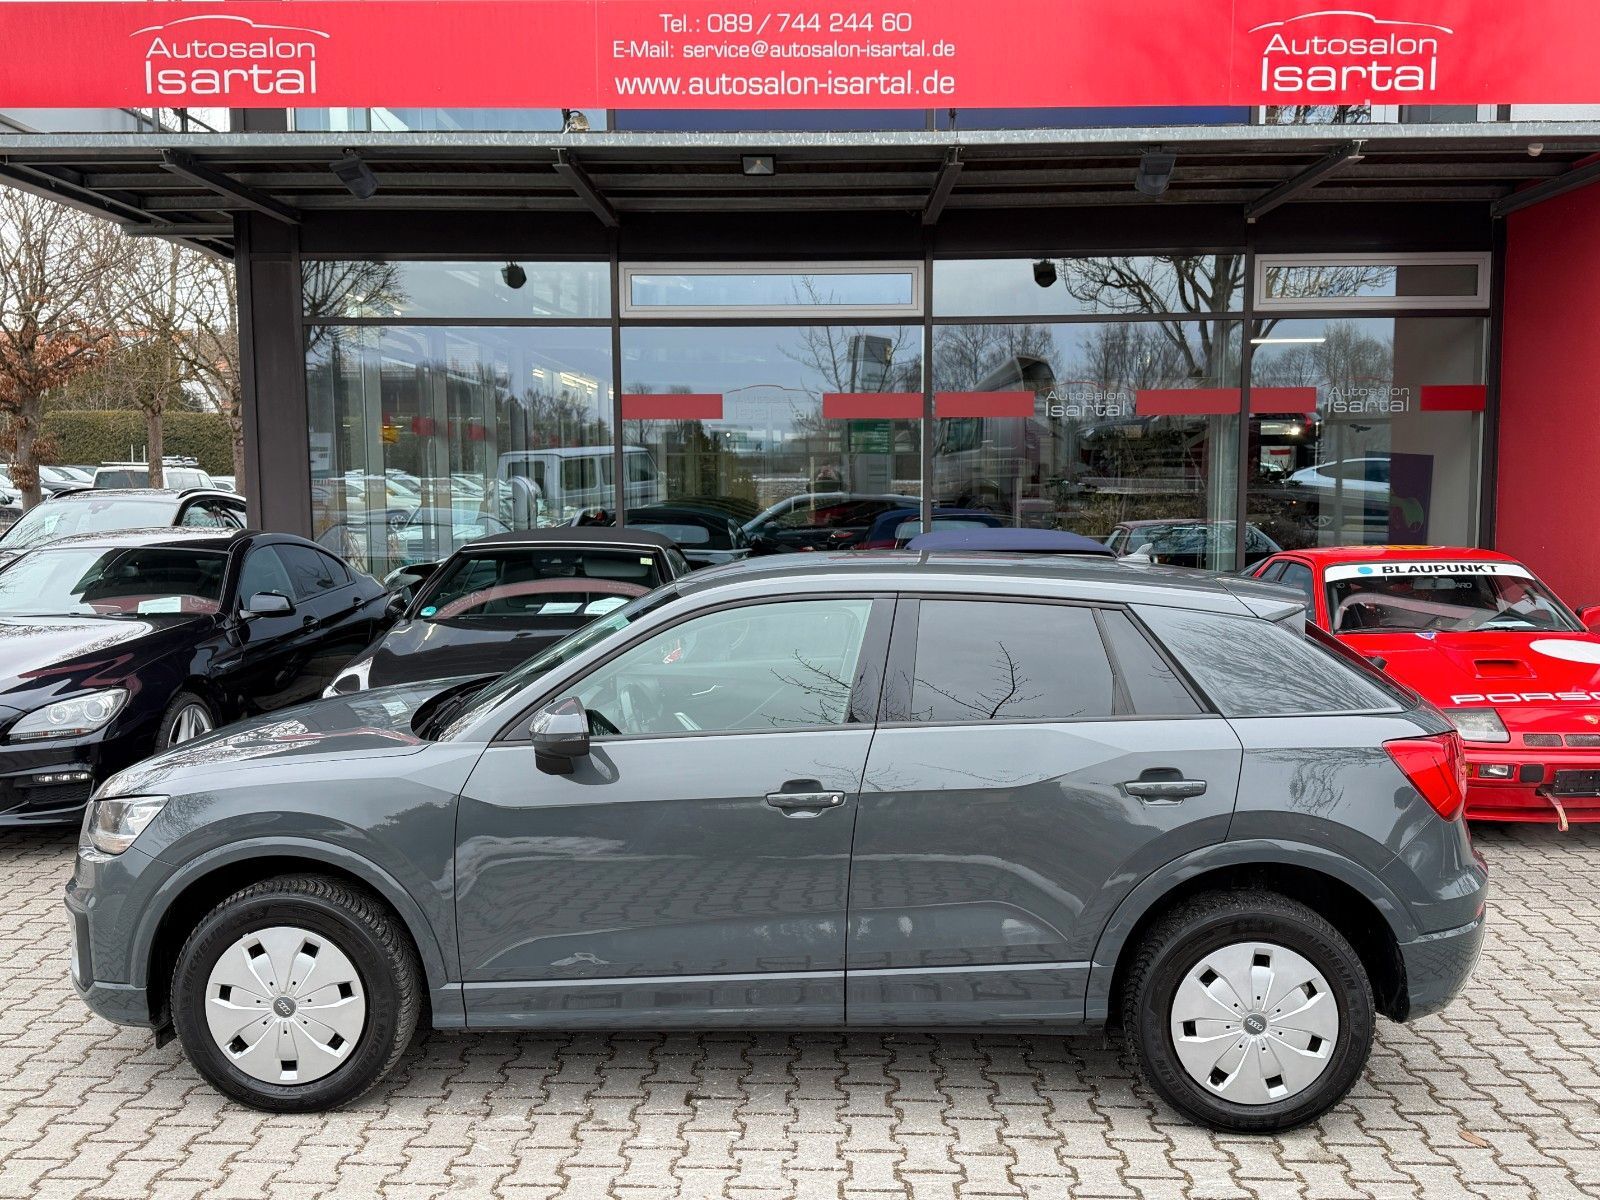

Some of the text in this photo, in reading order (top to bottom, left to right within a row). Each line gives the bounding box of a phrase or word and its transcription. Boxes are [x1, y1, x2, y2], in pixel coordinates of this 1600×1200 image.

[659, 13, 700, 33] Tel.:
[707, 13, 753, 33] 089
[776, 13, 821, 32] 744
[829, 12, 874, 32] 244
[881, 12, 912, 32] 60
[145, 37, 316, 59] Autosalon
[613, 39, 955, 58] E-Mail: service@autosalon-isartal.de
[1263, 33, 1437, 55] Autosalon
[145, 60, 317, 94] Isartal
[614, 69, 955, 96] www.autosalon-isartal.de
[1261, 56, 1437, 92] Isartal
[1046, 389, 1126, 401] Autosalon
[1329, 386, 1410, 396] Autosalon
[1045, 400, 1126, 417] Isartal
[1327, 396, 1410, 413] Isartal
[1382, 564, 1498, 574] BLAUPUNKT
